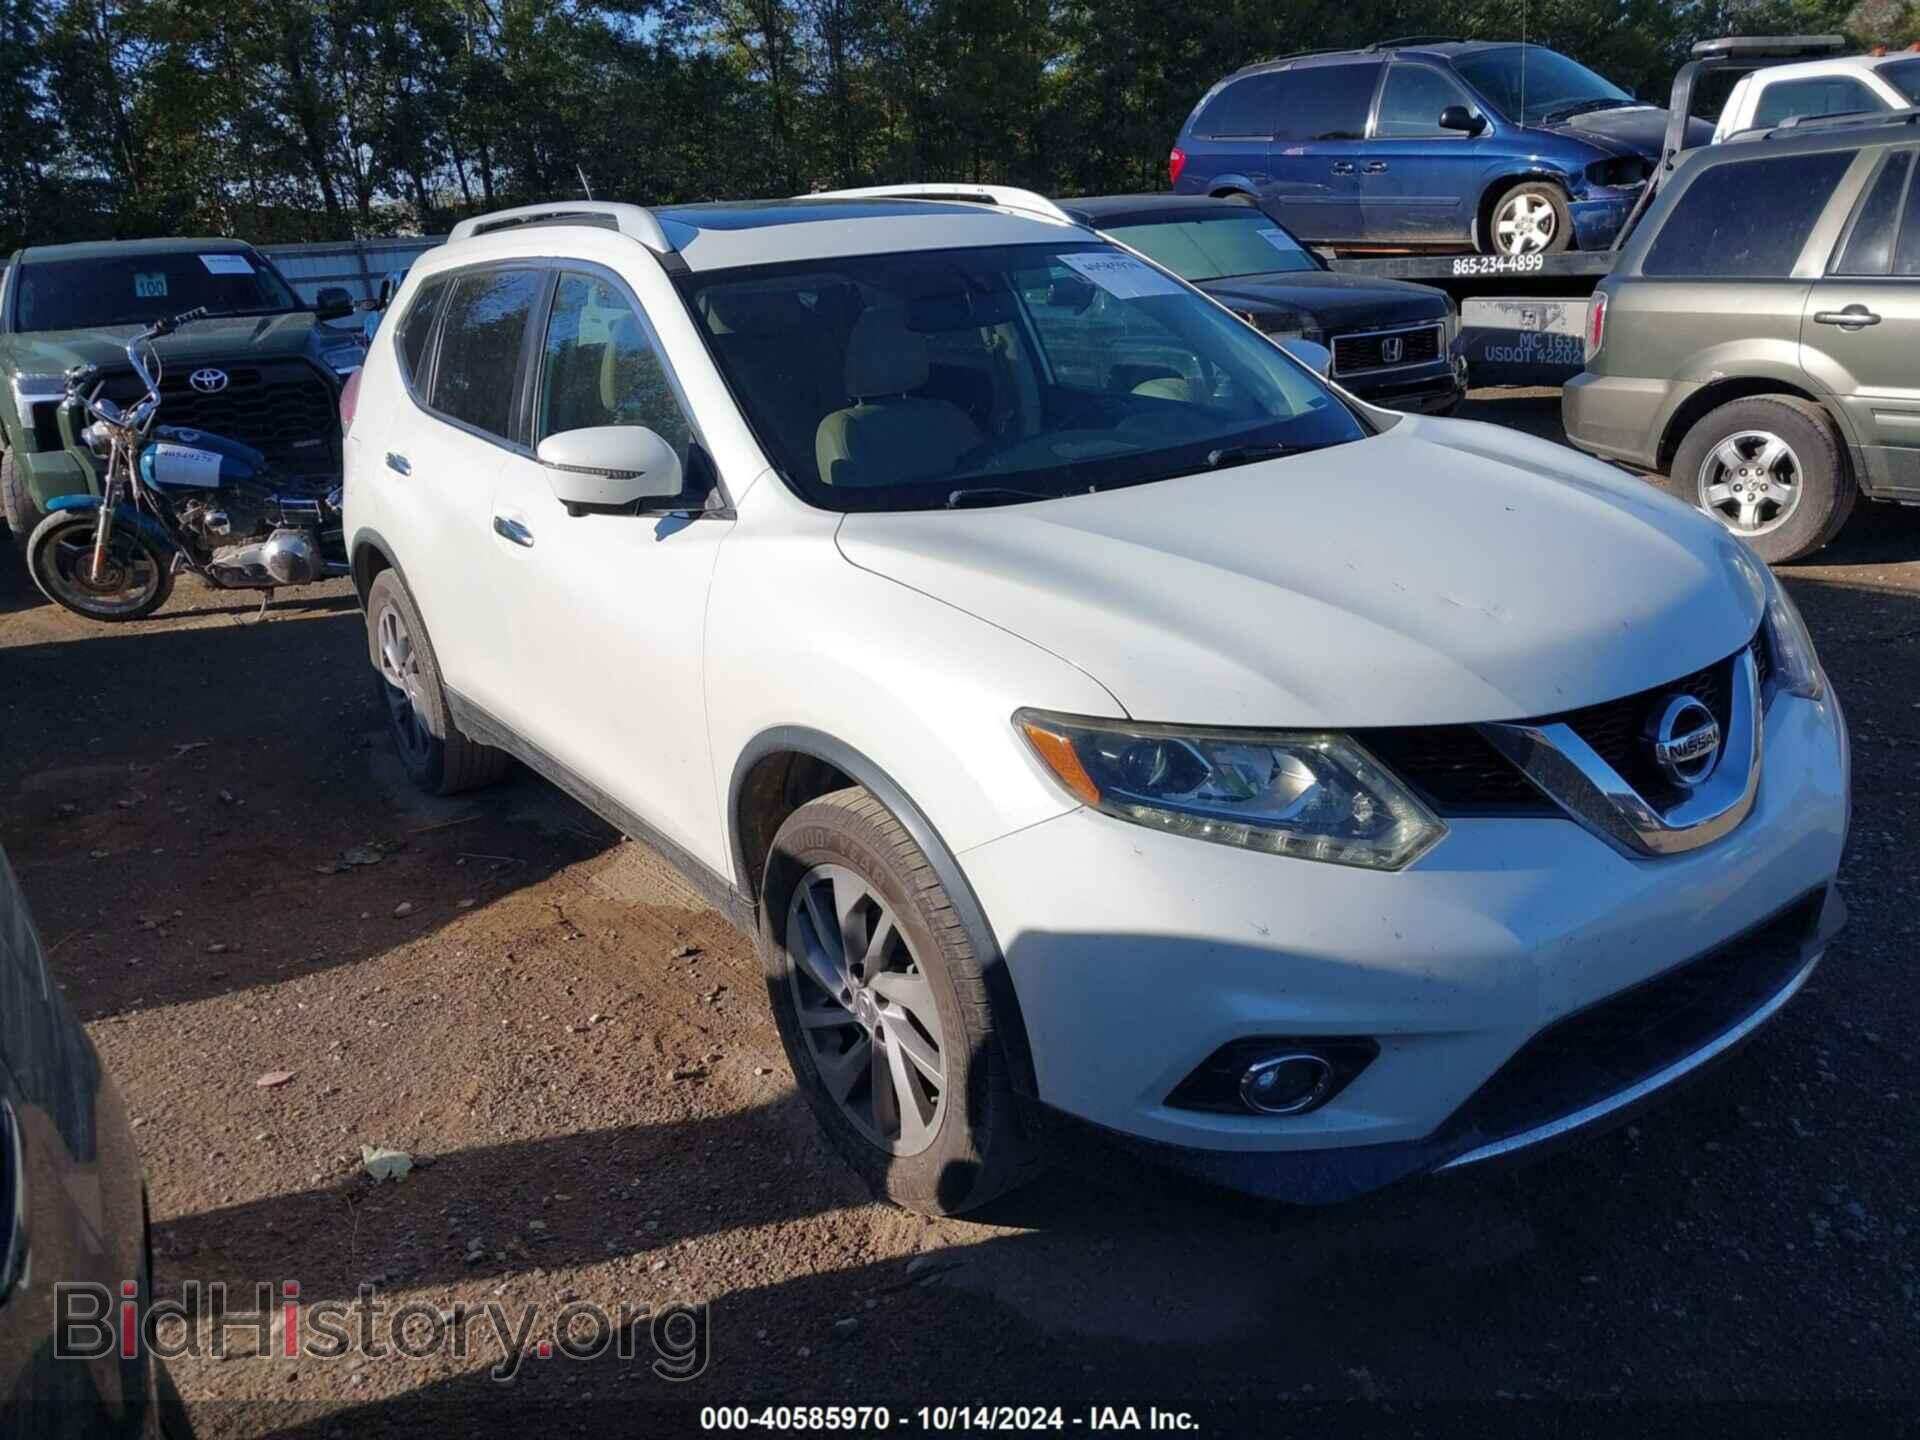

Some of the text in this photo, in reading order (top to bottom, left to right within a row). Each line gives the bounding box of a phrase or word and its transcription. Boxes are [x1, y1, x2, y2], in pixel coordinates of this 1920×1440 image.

[1453, 254, 1544, 275] 865-234-4899
[1519, 332, 1543, 349] MC
[1486, 346, 1533, 362] USDOT
[1669, 726, 1718, 758] NISSAN
